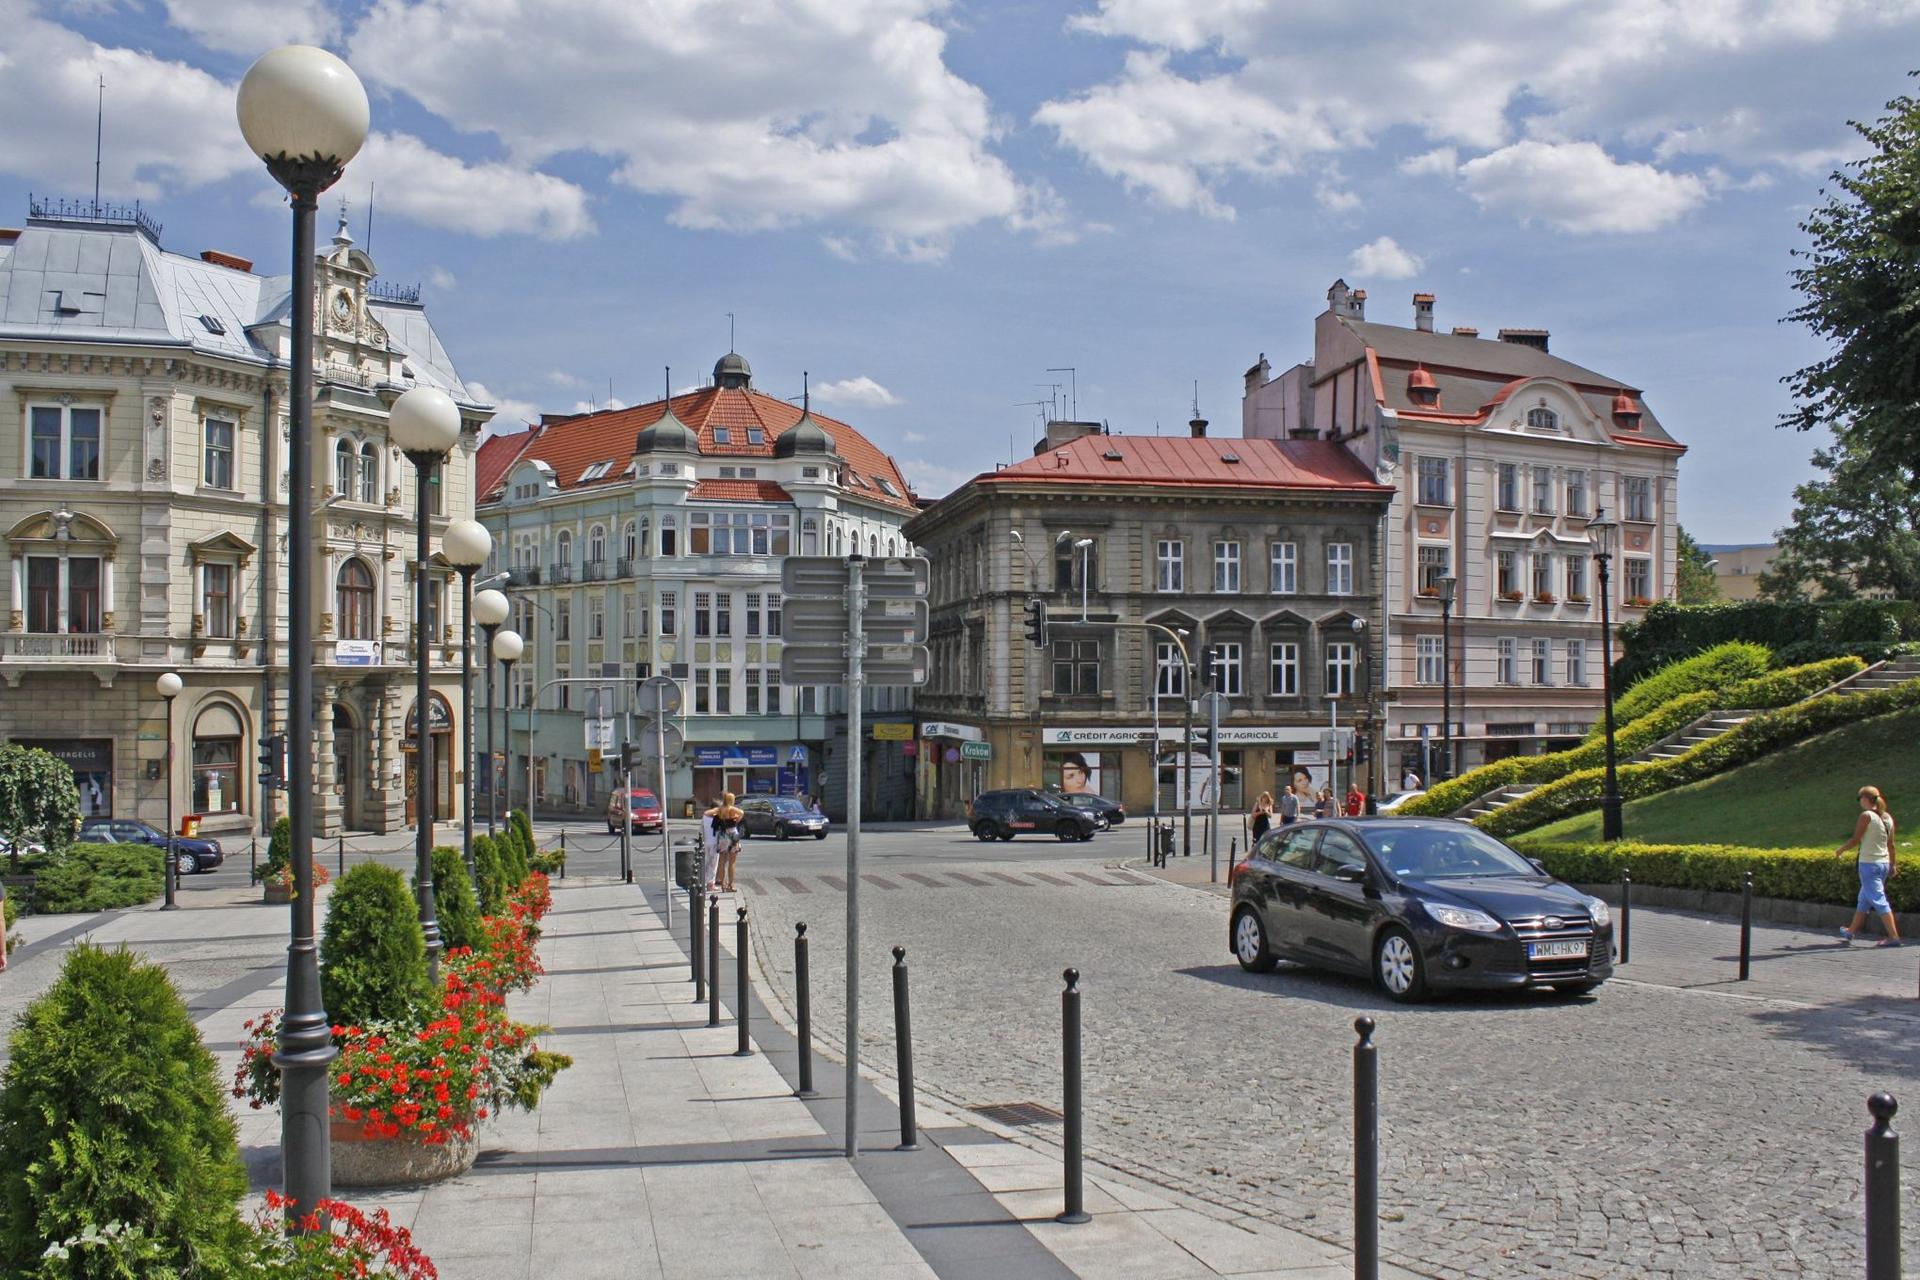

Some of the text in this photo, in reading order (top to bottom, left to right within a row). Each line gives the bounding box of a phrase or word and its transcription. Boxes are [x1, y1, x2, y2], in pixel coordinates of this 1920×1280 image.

[1108, 732, 1145, 740] AGRICO
[1233, 732, 1279, 740] AGRICOLE
[964, 744, 989, 757] Kraków
[1560, 941, 1585, 955] HK97
